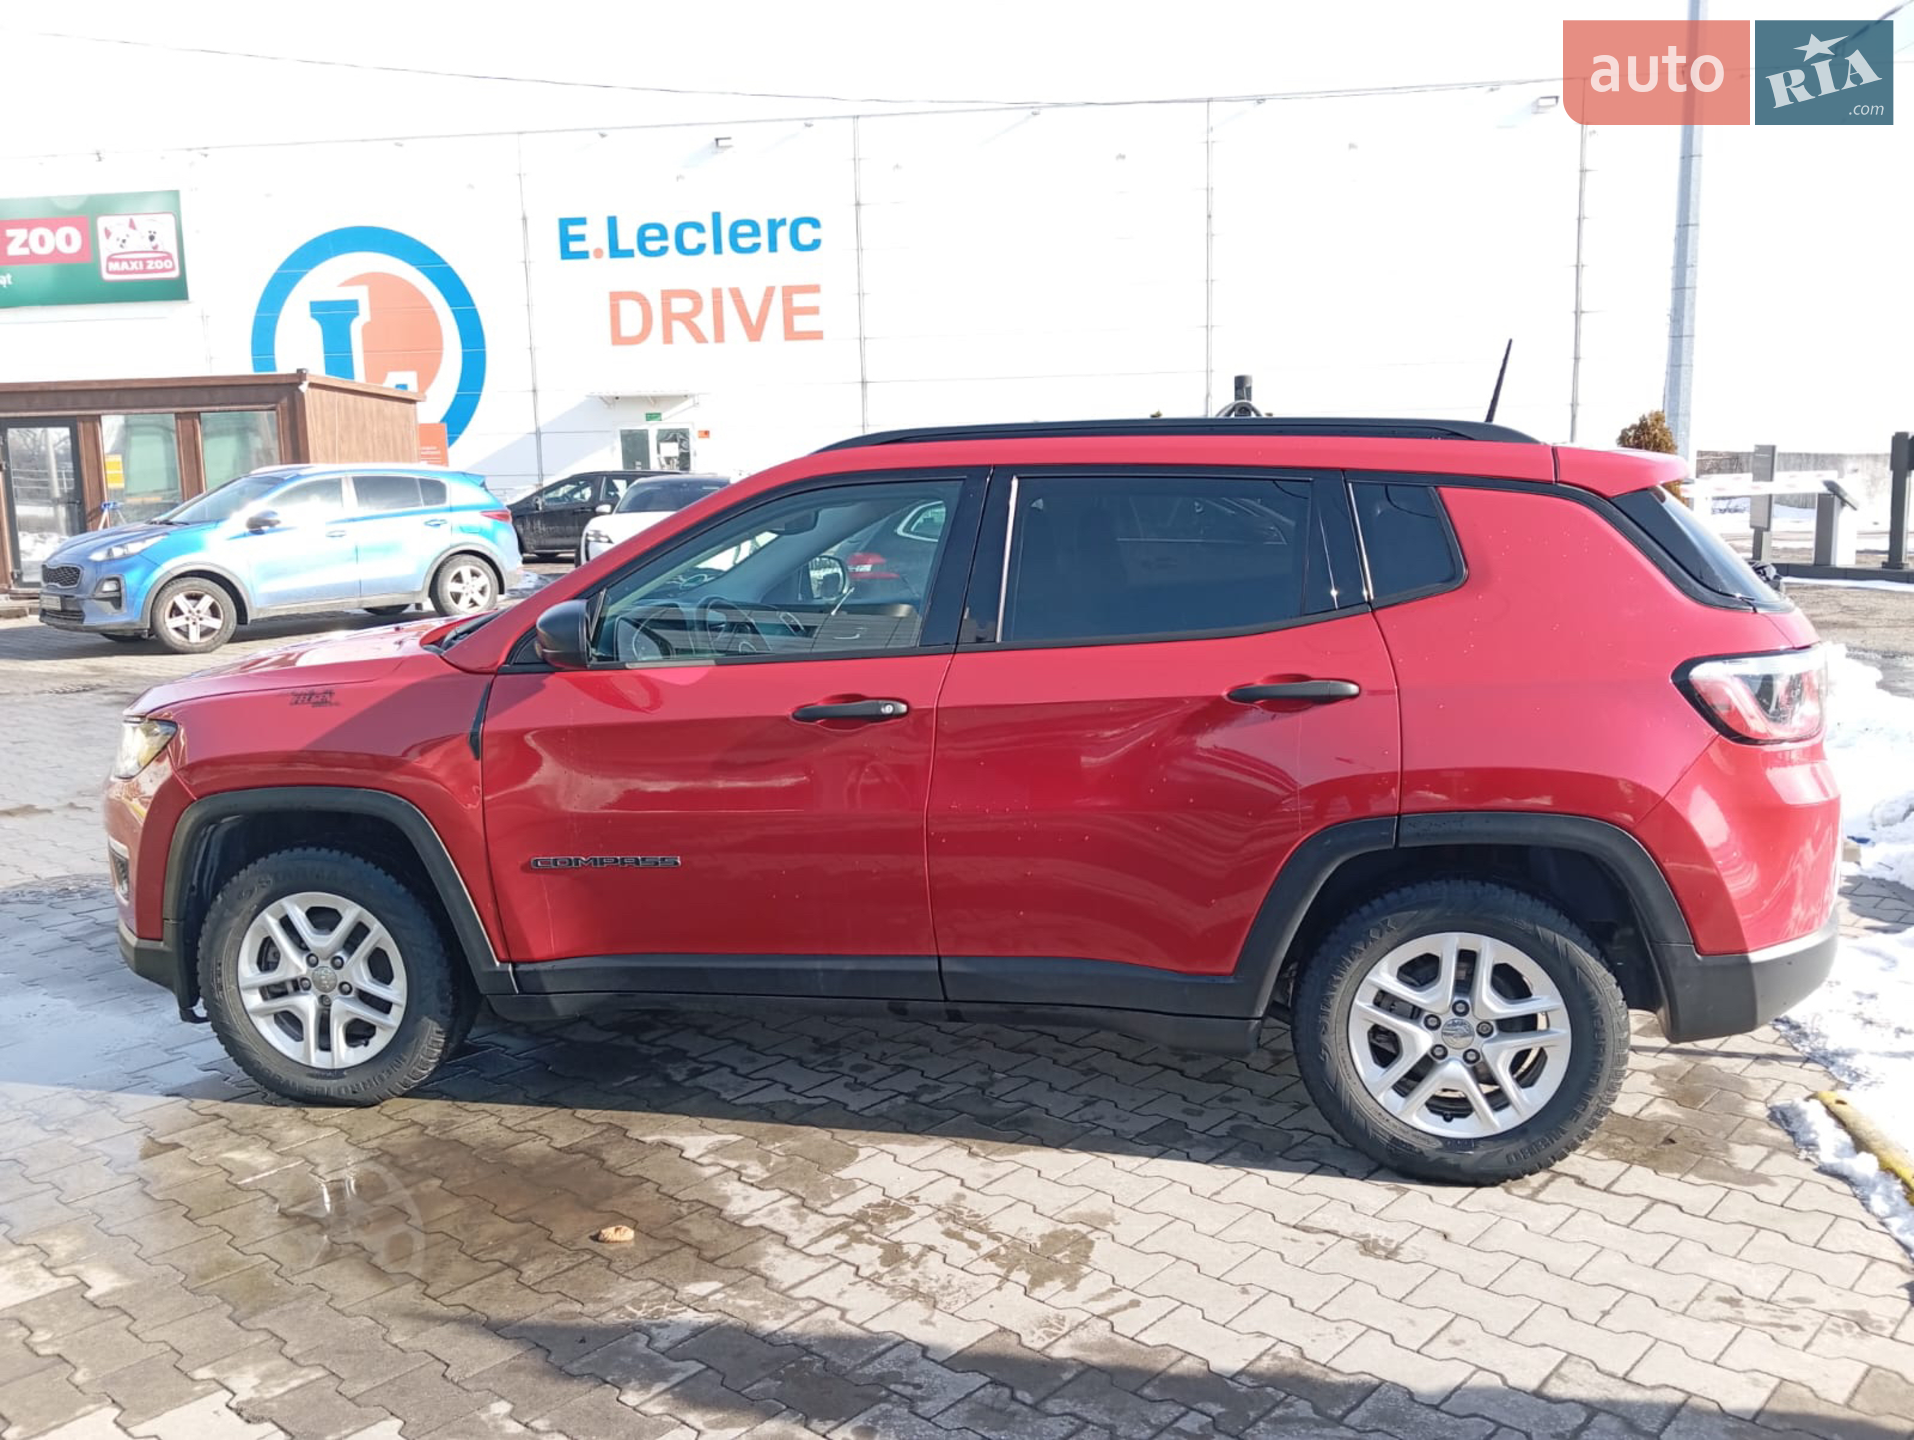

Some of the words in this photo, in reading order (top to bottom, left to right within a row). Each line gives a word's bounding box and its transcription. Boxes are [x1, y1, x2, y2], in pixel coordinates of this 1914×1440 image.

[5, 226, 83, 256] ZOO
[558, 211, 822, 261] E.Leclerc
[108, 260, 144, 272] MAXI
[146, 258, 174, 270] ZOO
[609, 284, 824, 346] DRIVE
[530, 855, 682, 870] COMPASS
